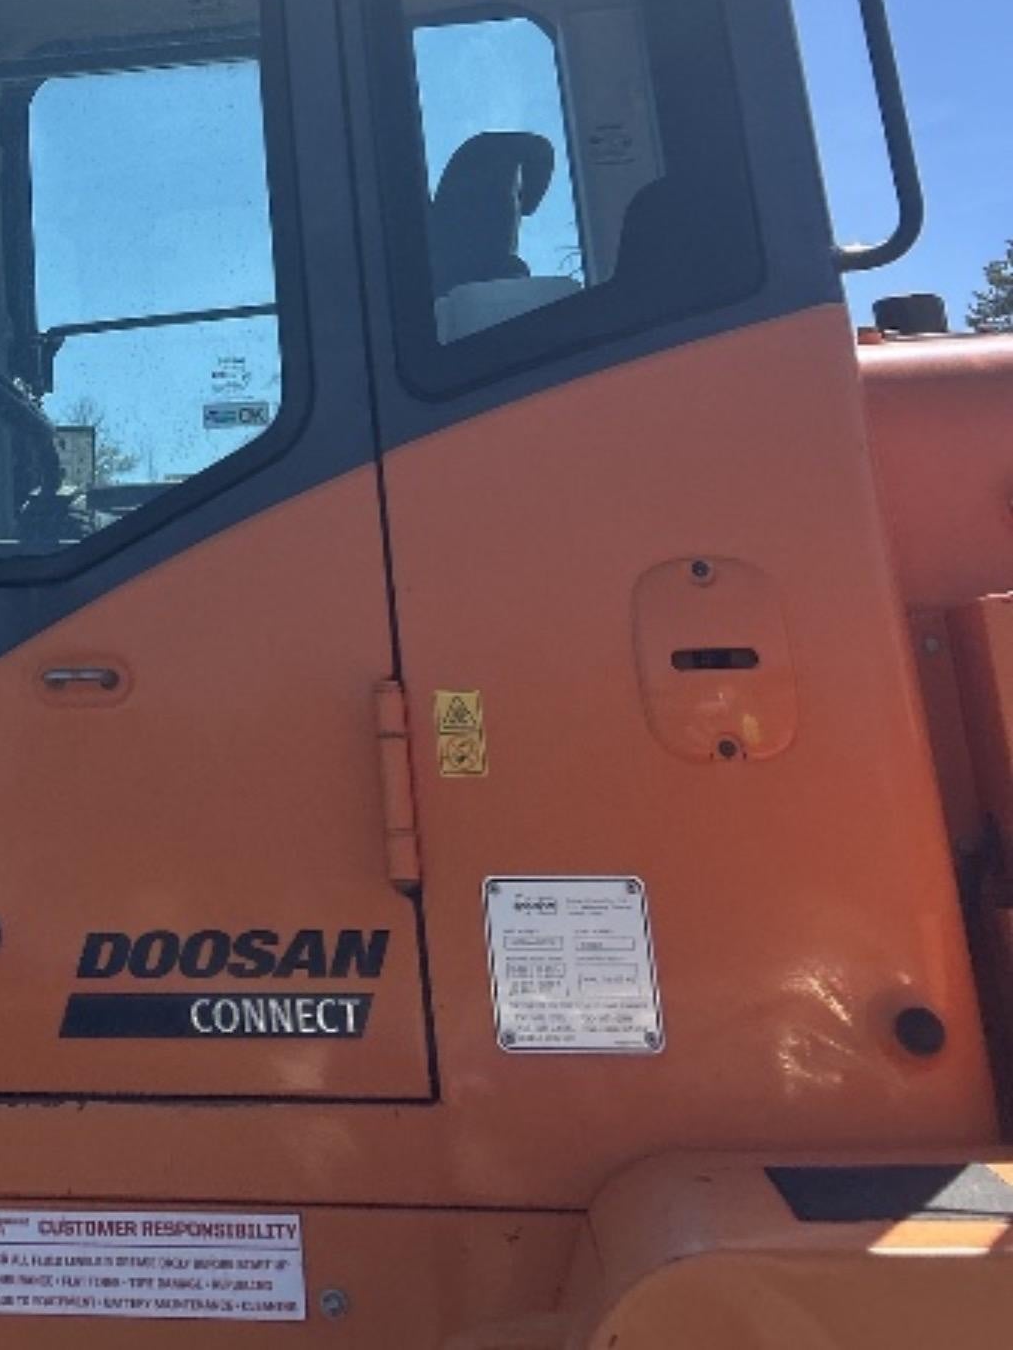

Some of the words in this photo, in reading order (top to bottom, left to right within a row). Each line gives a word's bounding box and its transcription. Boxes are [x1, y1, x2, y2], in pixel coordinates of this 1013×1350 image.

[76, 930, 390, 978] DOOSAN
[190, 998, 360, 1033] CONNECT
[38, 1220, 138, 1237] CUSTOMER
[142, 1221, 297, 1239] RESPONSIBILITY
